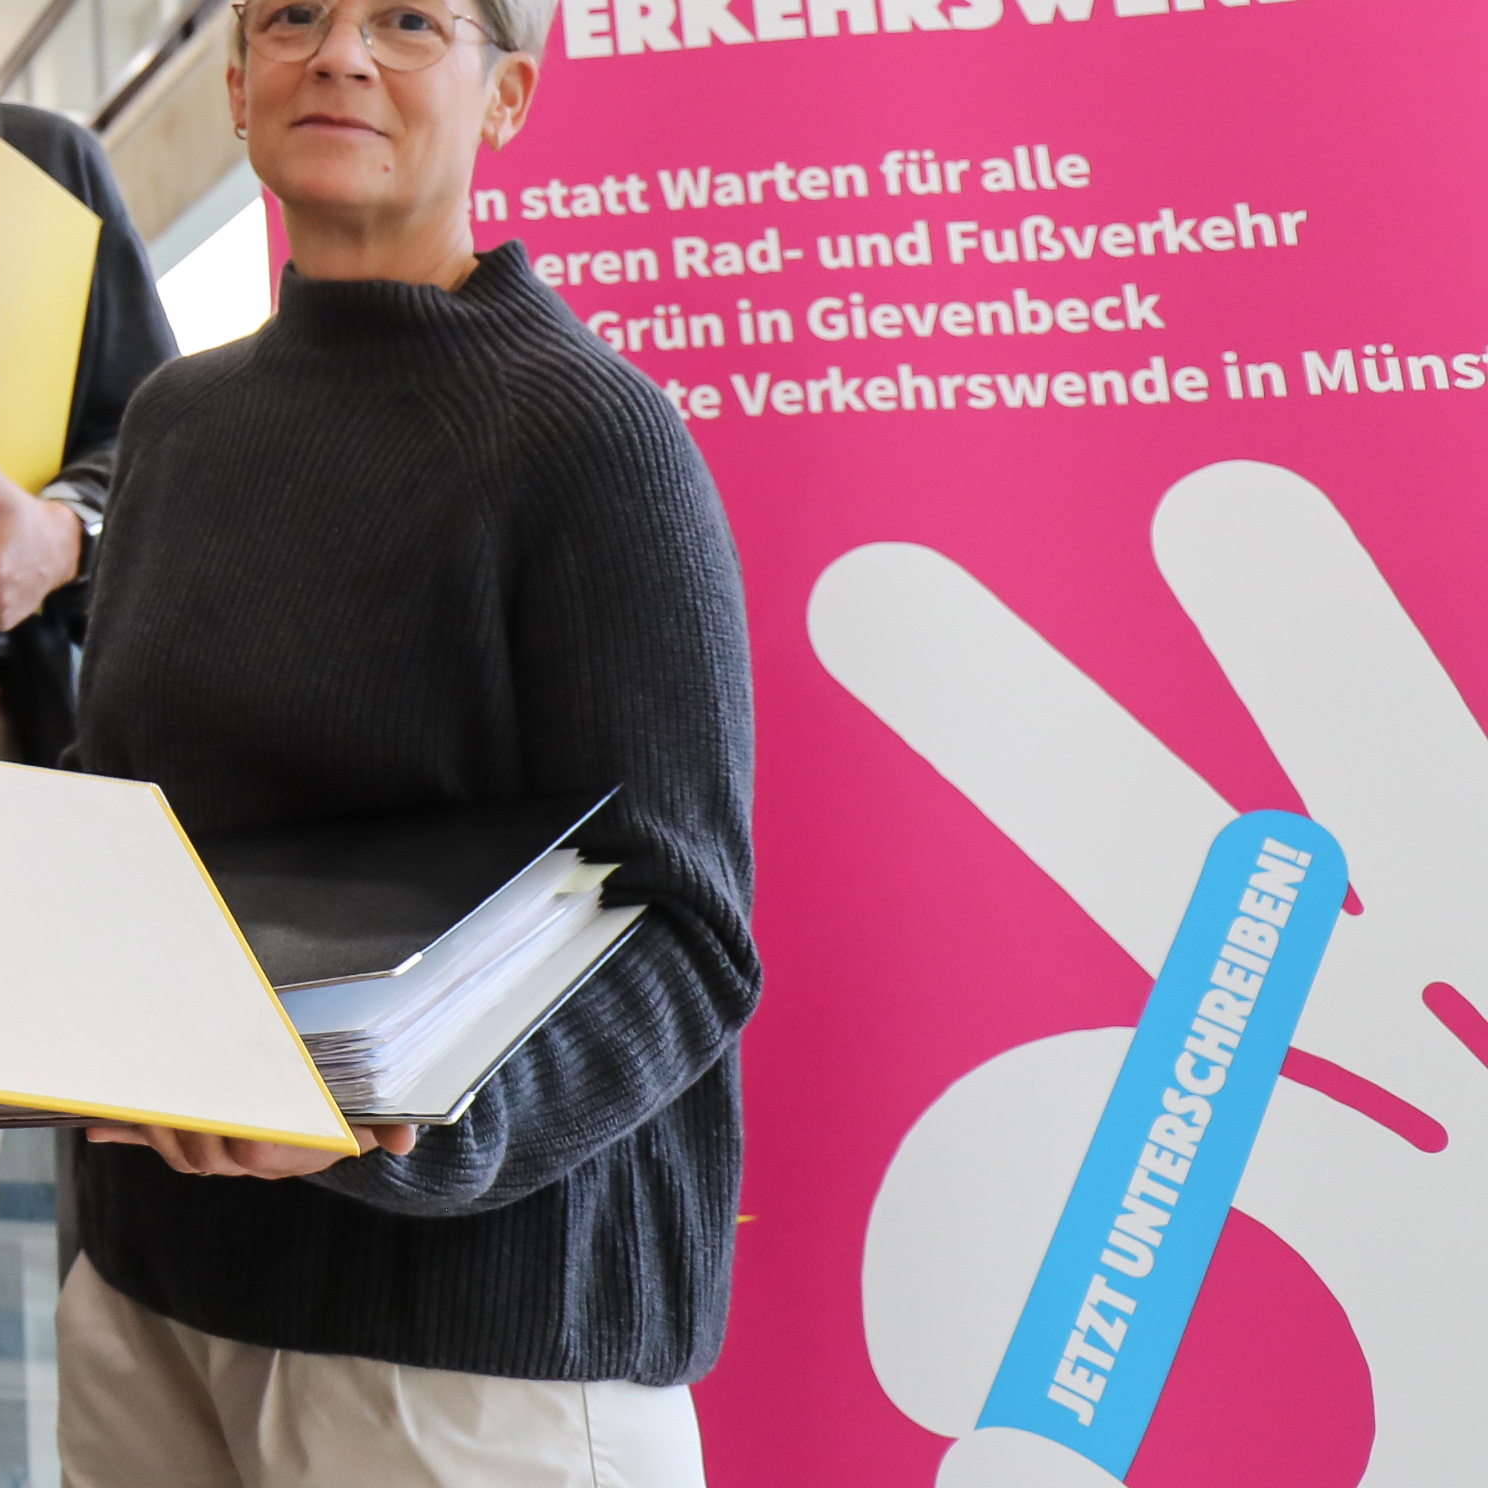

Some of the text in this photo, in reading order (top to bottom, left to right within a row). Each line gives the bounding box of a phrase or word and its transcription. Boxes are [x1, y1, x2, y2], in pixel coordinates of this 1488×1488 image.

[469, 144, 1091, 222] n statt Warten für alle
[533, 200, 1308, 287] eren Rad- und Fußverkehr
[586, 283, 1166, 352] Grün in Gievenbeck
[660, 343, 1488, 421] te Verkehrswende in Müns
[1046, 836, 1314, 1428] JETZT UNTERSCHREIBEN!
